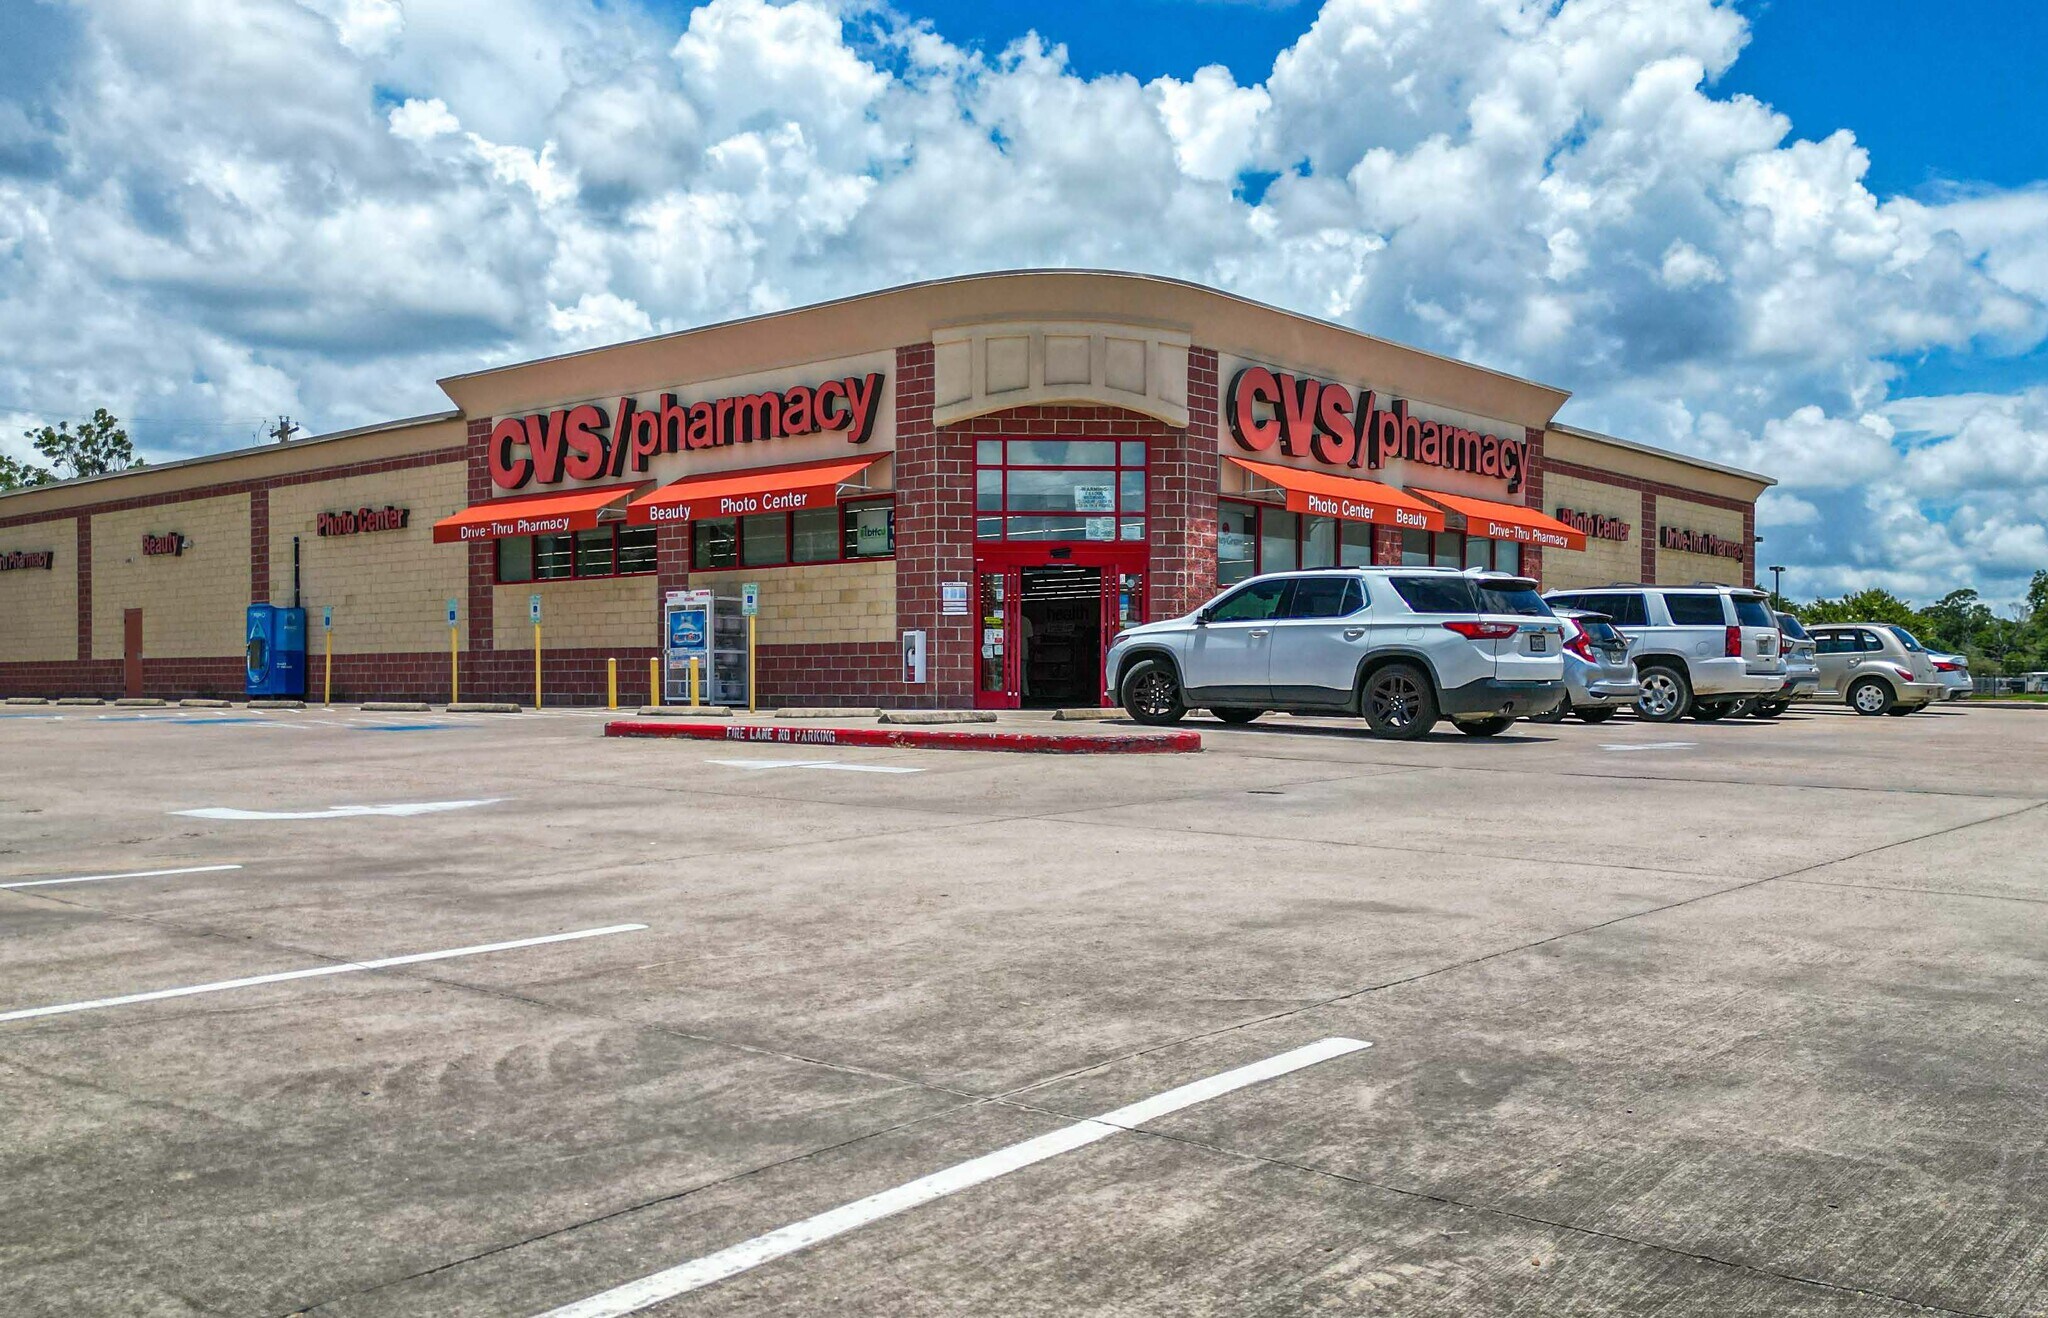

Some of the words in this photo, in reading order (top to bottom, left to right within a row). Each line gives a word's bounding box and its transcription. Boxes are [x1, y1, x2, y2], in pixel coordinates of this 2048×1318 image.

[488, 374, 884, 489] CVS/pharmacy
[1230, 366, 1531, 493] CVS/pharmacy
[650, 504, 691, 521] Beauty
[720, 498, 757, 514] Photo
[763, 492, 808, 511] Center
[1308, 495, 1338, 515] Photo
[1342, 499, 1375, 520] Center
[317, 511, 357, 536] Photo
[358, 505, 407, 532] Center
[461, 522, 513, 539] Drive-Thru
[518, 517, 569, 532] Pharmacy
[1396, 509, 1427, 530] Beauty
[1596, 513, 1631, 541] Center
[143, 532, 182, 557] Beauty
[1489, 522, 1530, 540] Drive-Thru
[1532, 529, 1568, 548] Pharmacy
[1662, 526, 1708, 554] Drive-Thru
[1709, 533, 1744, 563] Pharmacy
[8, 551, 51, 570] Pharmacy
[726, 727, 746, 739] FIRE
[749, 728, 774, 741] LANE
[778, 729, 790, 742] NO
[795, 730, 836, 743] PARKING
